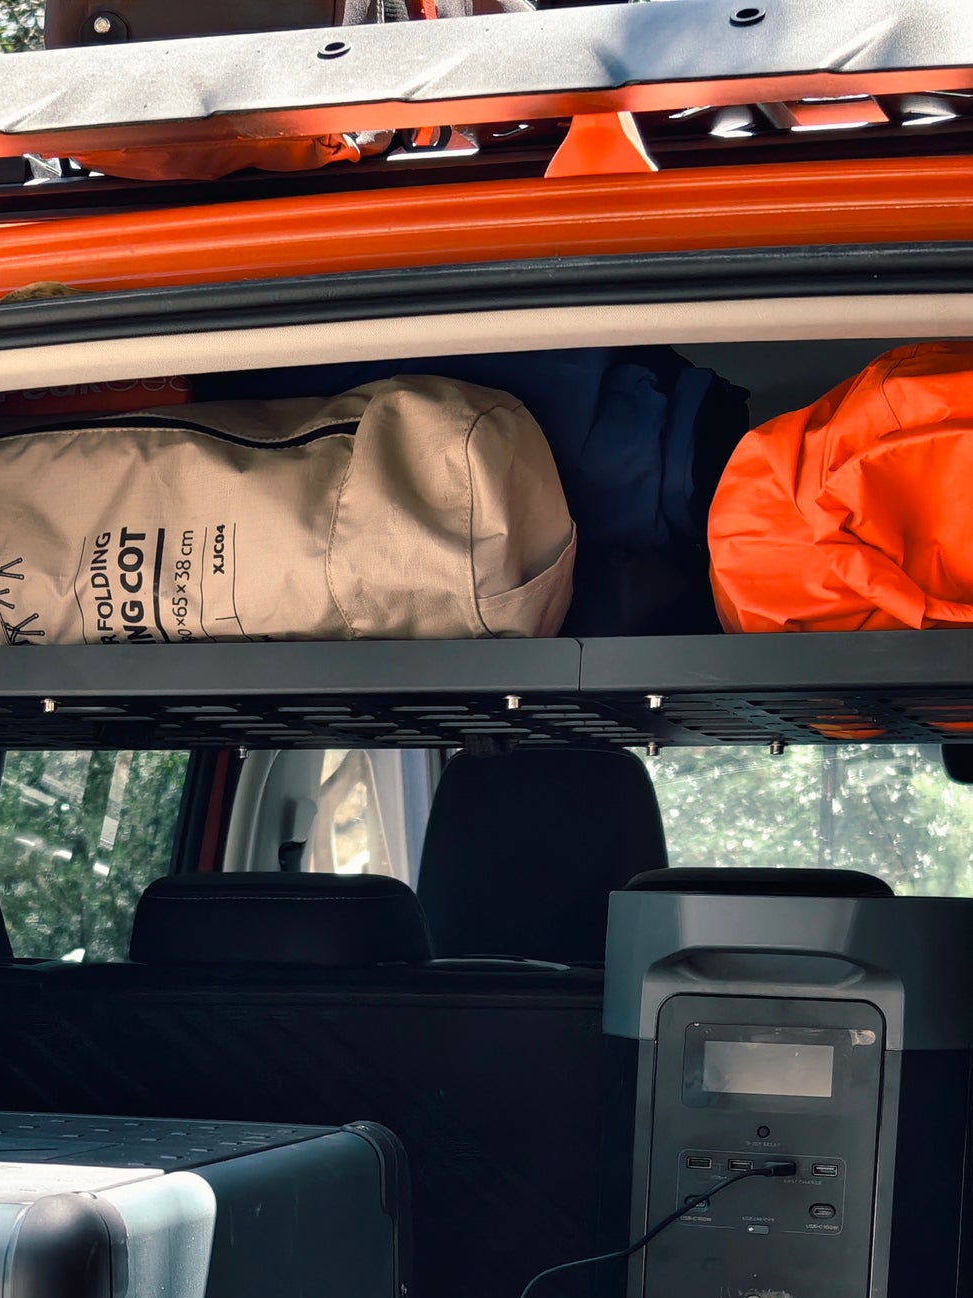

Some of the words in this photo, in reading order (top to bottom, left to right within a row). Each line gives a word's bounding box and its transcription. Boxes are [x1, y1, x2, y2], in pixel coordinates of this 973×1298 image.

[117, 526, 146, 593] COT
[181, 530, 194, 556] cm
[213, 524, 225, 575] XJC04
[90, 531, 114, 631] FOLDING
[174, 560, 191, 581] 38
